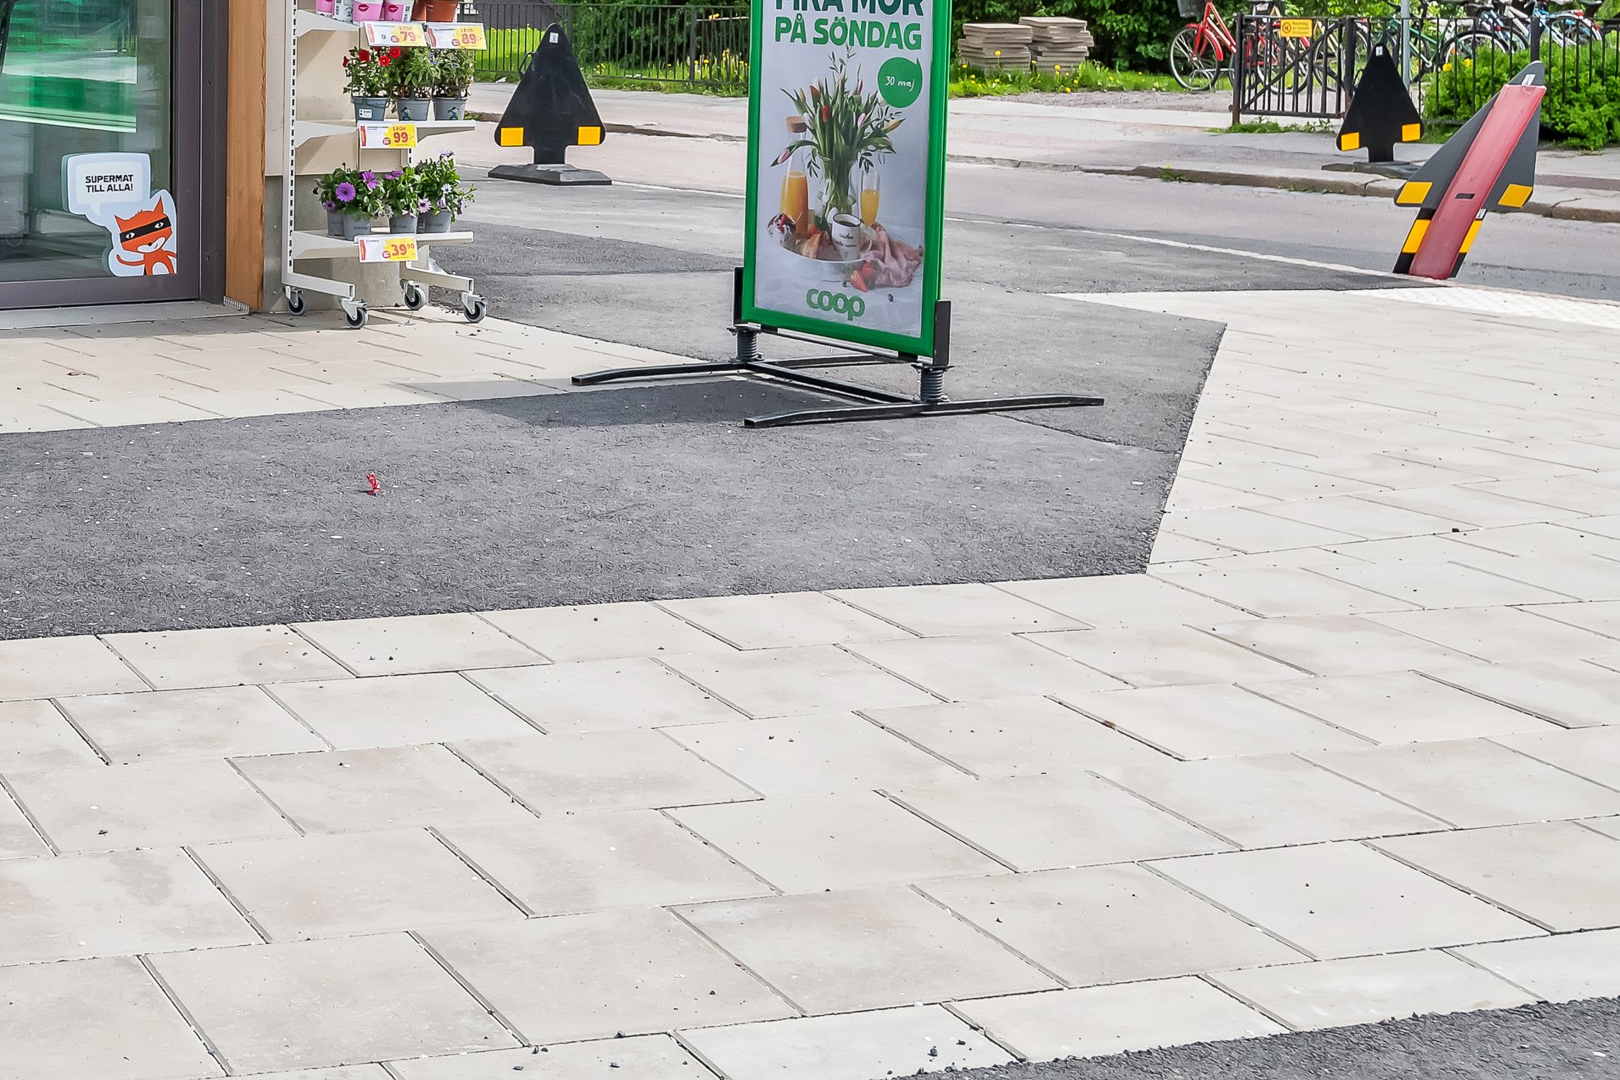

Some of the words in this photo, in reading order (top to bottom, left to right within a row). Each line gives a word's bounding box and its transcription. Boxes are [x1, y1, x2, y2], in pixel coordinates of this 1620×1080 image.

[775, 12, 807, 44] PÅ
[813, 16, 922, 50] SÖNDAG
[884, 76, 895, 87] 30
[897, 78, 916, 92] maj
[85, 174, 134, 183] SUPERMAT
[86, 184, 105, 192] TILL
[106, 183, 133, 192] ALLA!
[806, 288, 866, 321] coop
